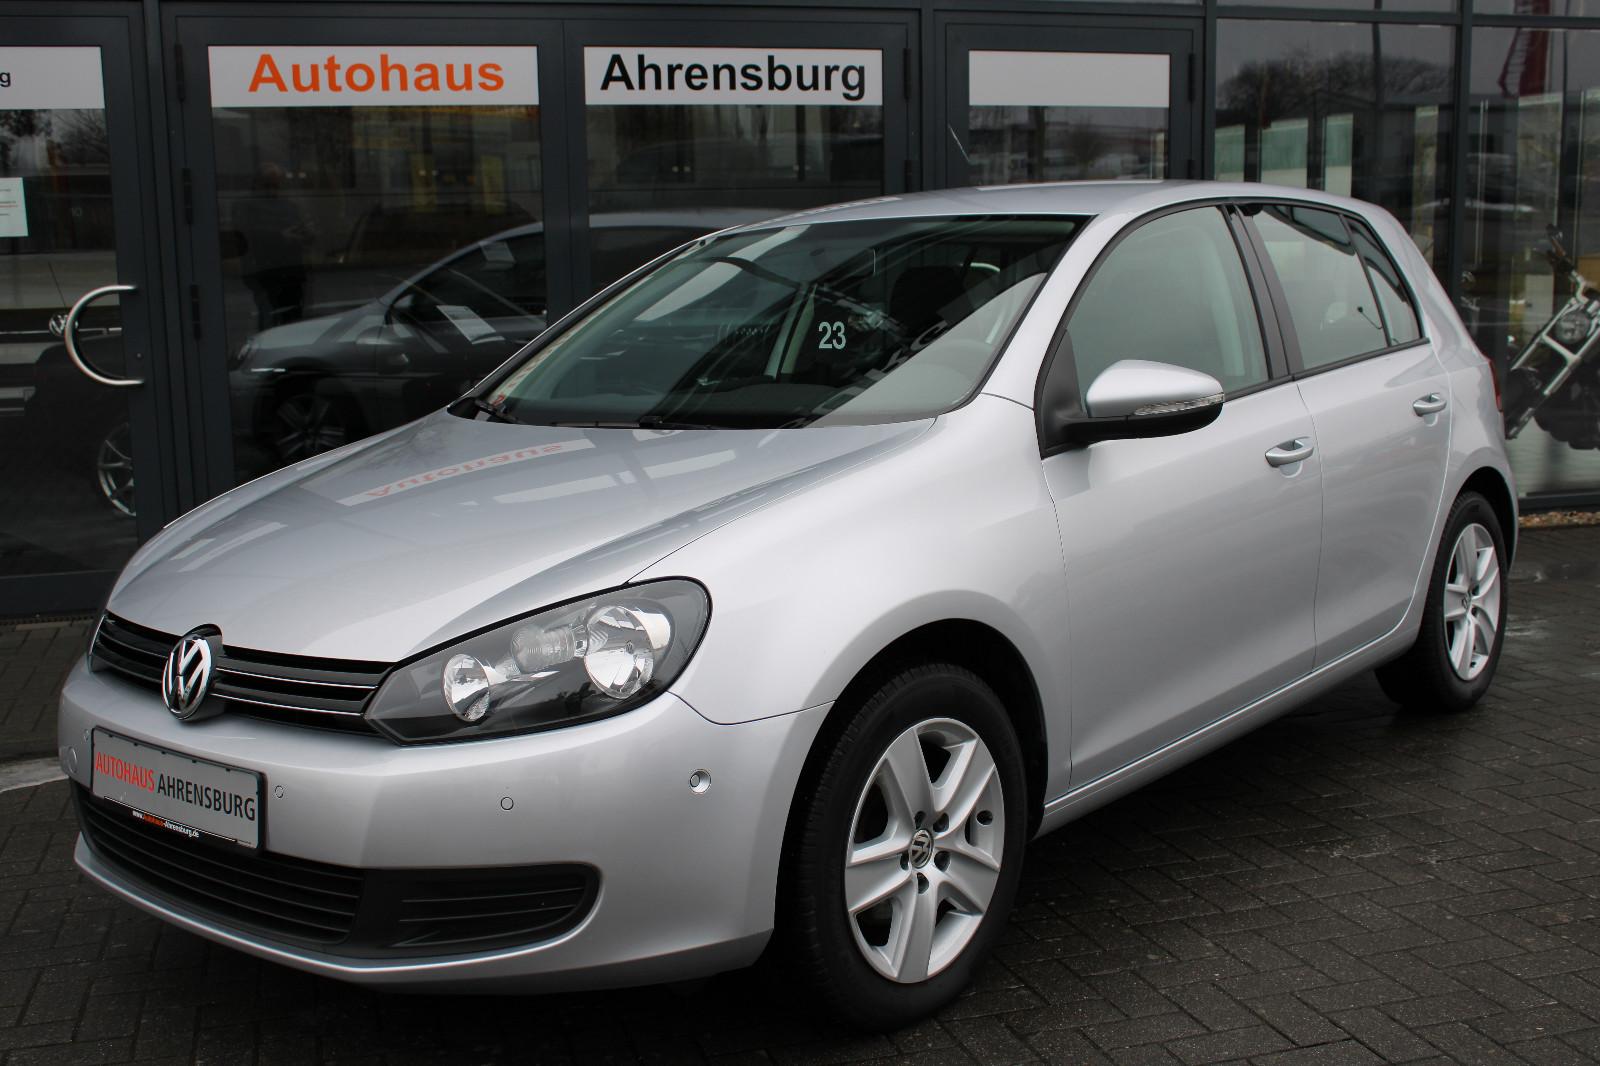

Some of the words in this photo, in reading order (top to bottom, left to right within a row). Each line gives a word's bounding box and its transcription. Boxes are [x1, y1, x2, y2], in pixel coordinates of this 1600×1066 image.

[248, 53, 505, 93] Autohaus
[600, 53, 866, 101] Ahrensburg
[818, 321, 847, 350] 23
[95, 751, 155, 793] AUTOHAUS
[157, 773, 256, 821] AHRENSBURG
